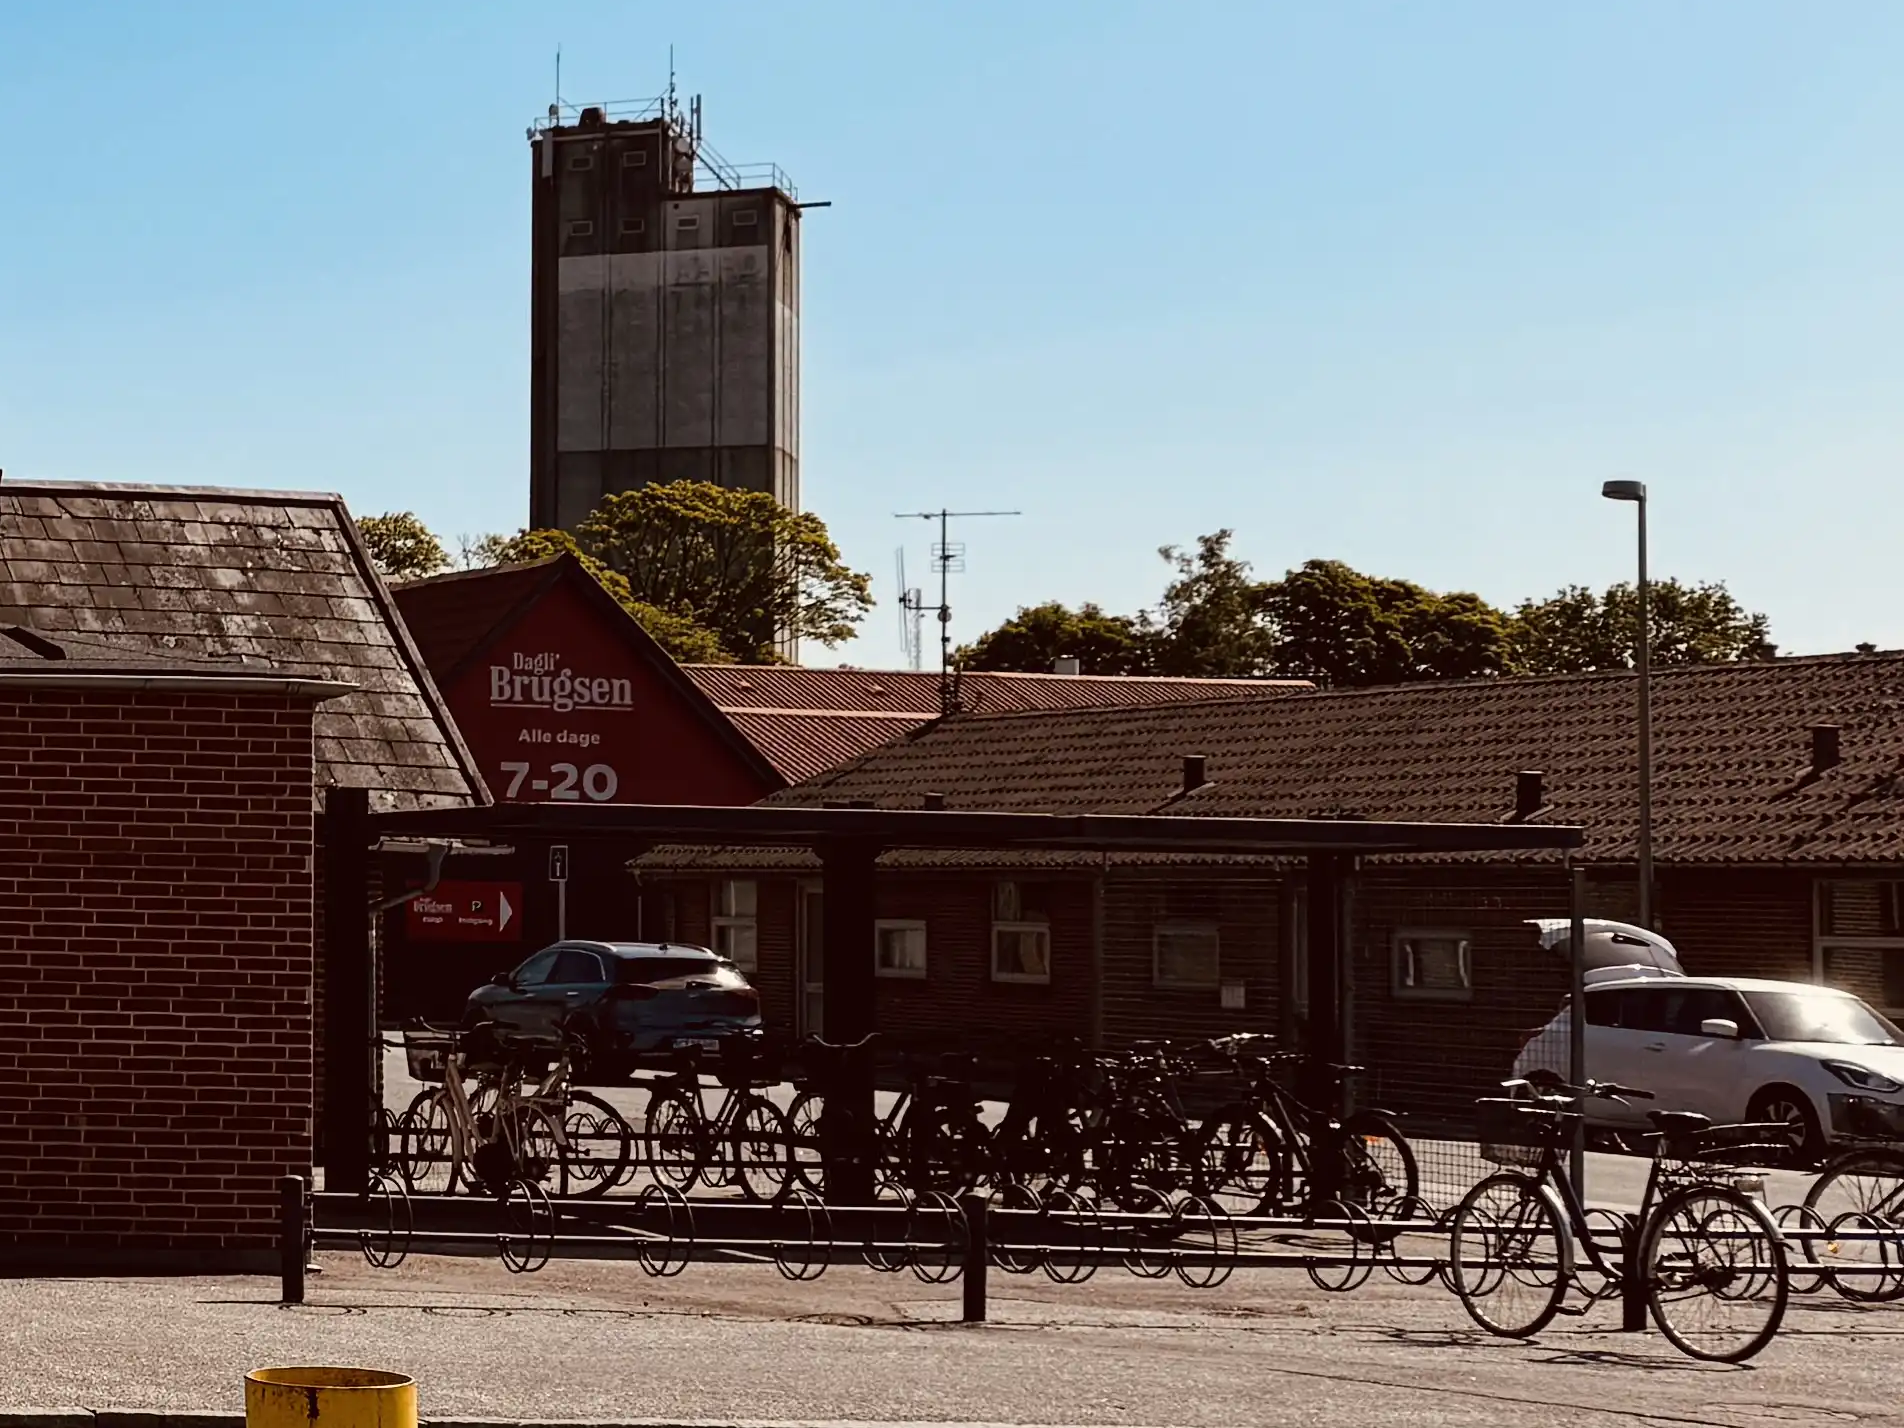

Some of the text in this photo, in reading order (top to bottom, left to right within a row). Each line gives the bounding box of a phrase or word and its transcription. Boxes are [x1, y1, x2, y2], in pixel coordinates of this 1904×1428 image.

[513, 652, 560, 675] Dagli'
[490, 666, 634, 712] Brugsen
[518, 728, 600, 747] Alle dage
[500, 761, 618, 801] 7-20
